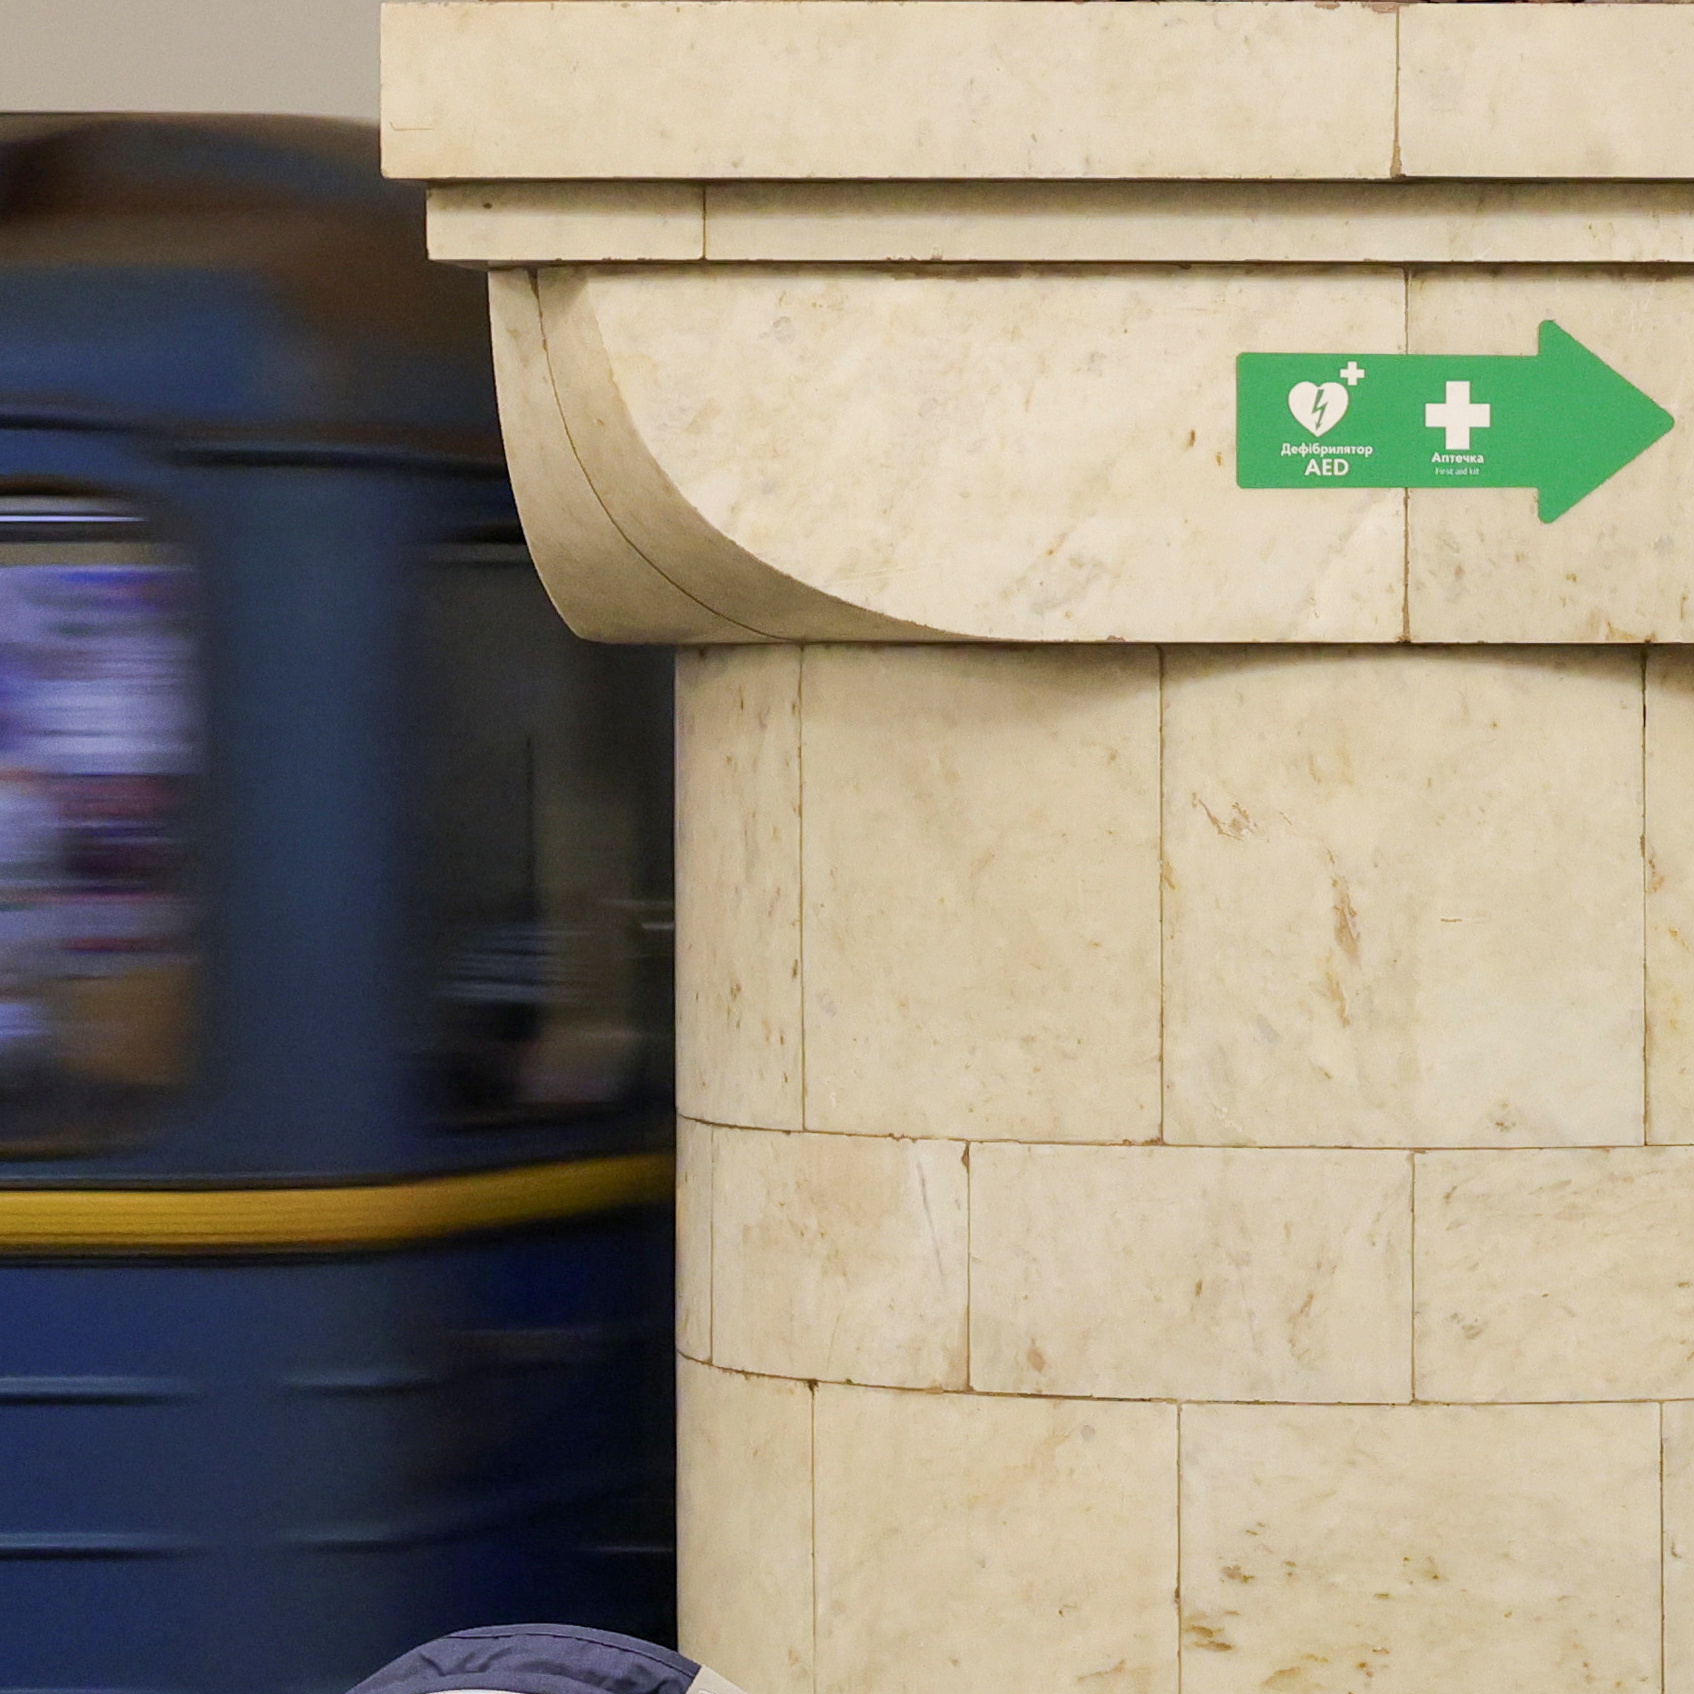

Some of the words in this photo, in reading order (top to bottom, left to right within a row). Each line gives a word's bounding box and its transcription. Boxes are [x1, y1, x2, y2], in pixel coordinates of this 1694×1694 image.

[1281, 443, 1374, 458] Дефібрилятор
[1431, 452, 1485, 464] Аптечка
[1304, 458, 1350, 476] AED
[1455, 467, 1468, 476] aid
[1469, 467, 1481, 476] kit
